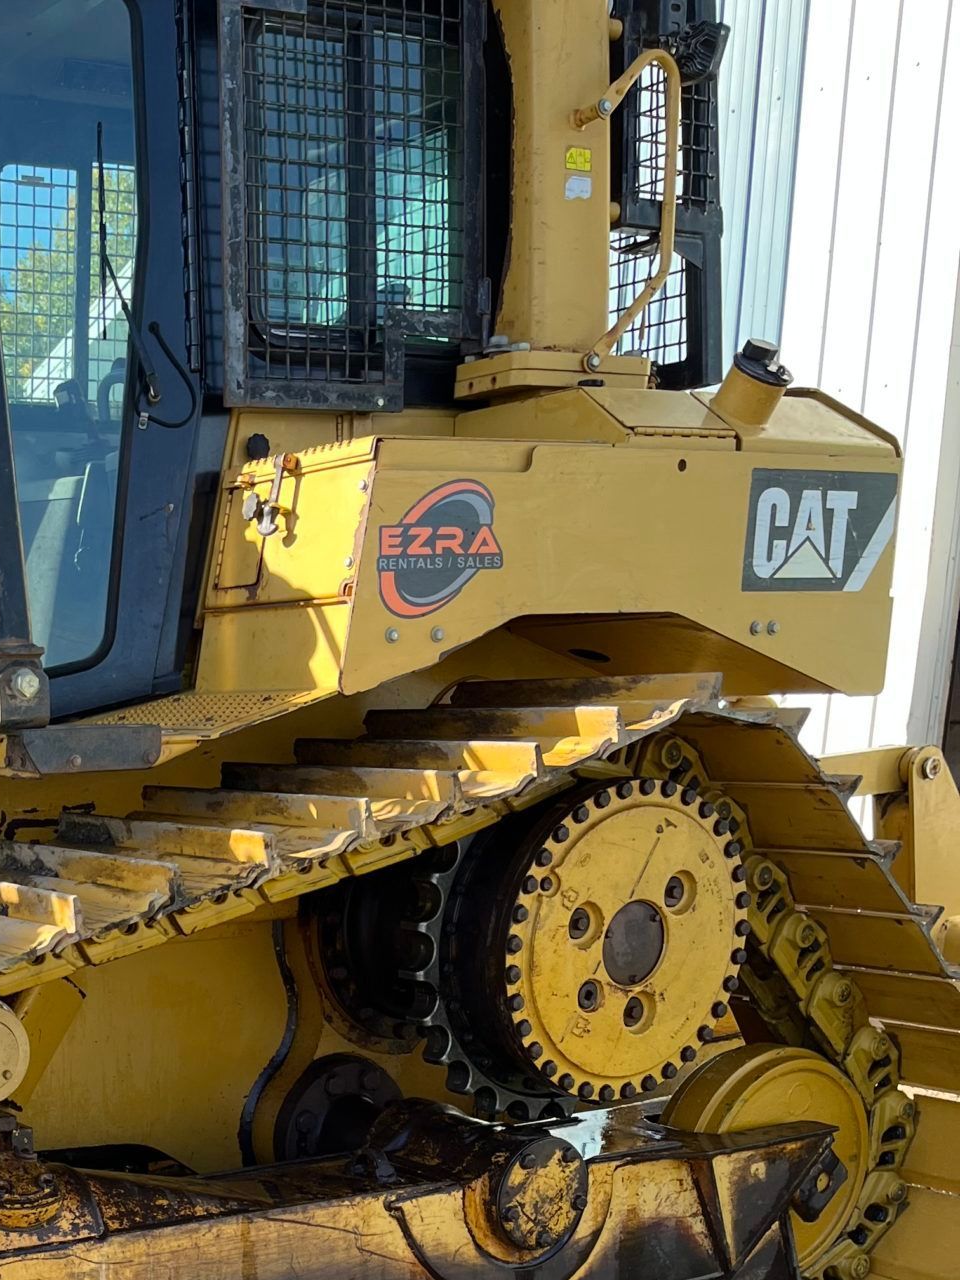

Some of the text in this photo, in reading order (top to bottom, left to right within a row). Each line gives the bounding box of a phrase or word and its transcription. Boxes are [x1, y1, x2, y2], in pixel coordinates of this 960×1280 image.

[381, 526, 500, 555] EZRA
[752, 487, 858, 579] CAT
[379, 558, 443, 569] RENTALS
[457, 556, 501, 568] SALES
